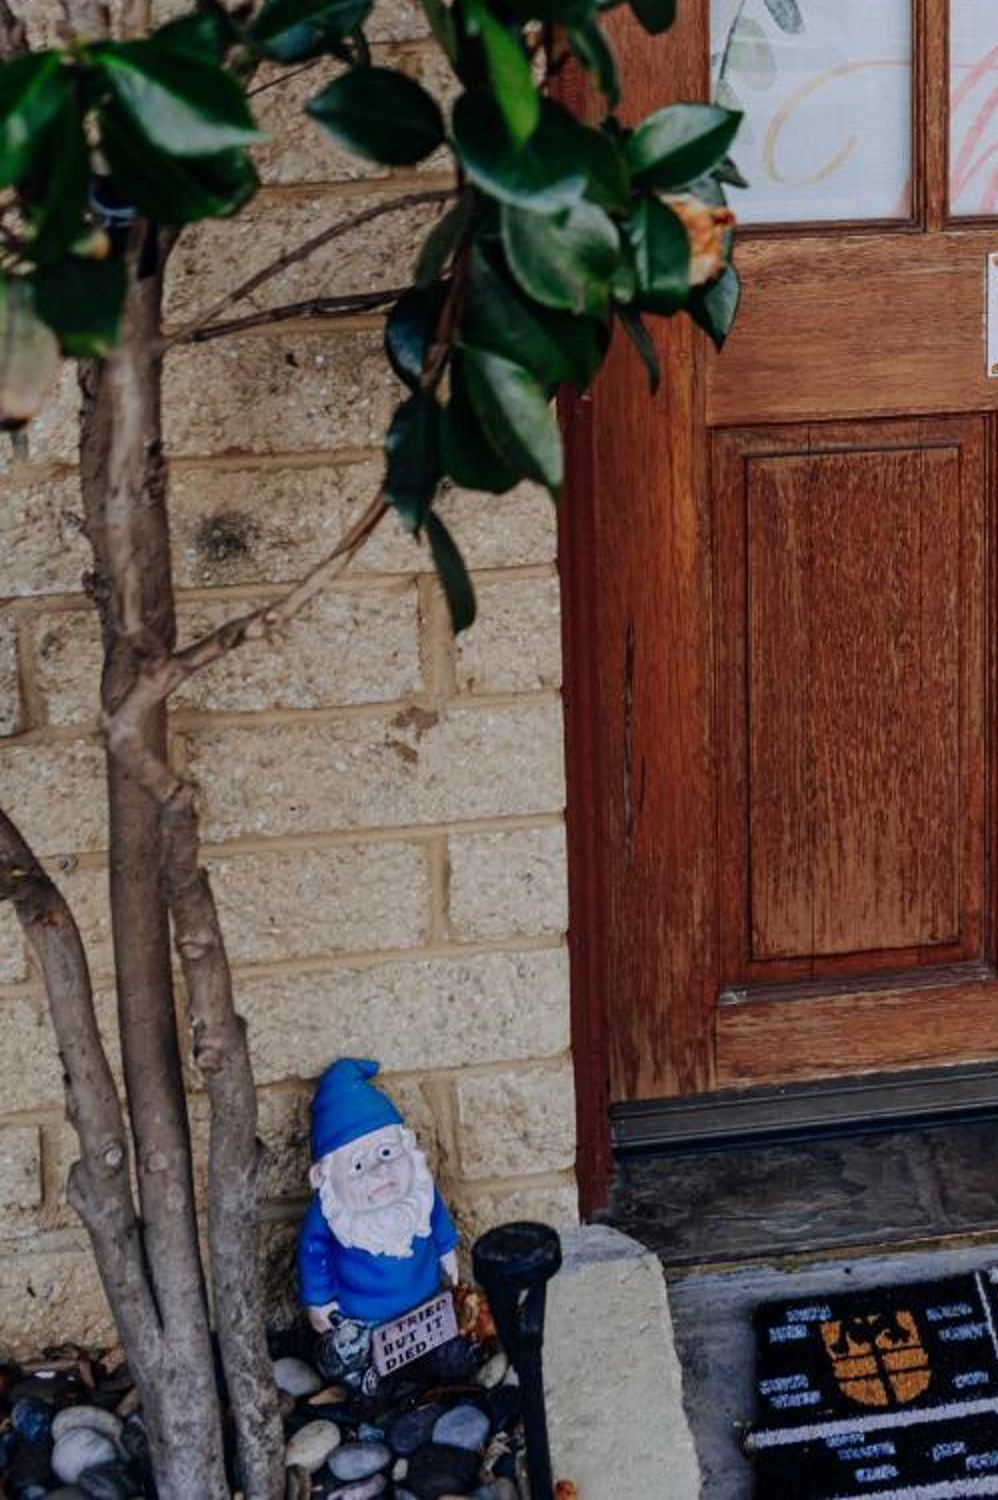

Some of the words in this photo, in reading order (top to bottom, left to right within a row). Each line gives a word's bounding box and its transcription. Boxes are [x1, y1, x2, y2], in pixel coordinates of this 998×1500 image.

[396, 1299, 447, 1333] TRIED
[383, 1329, 417, 1357] BUT
[426, 1315, 443, 1333] IT
